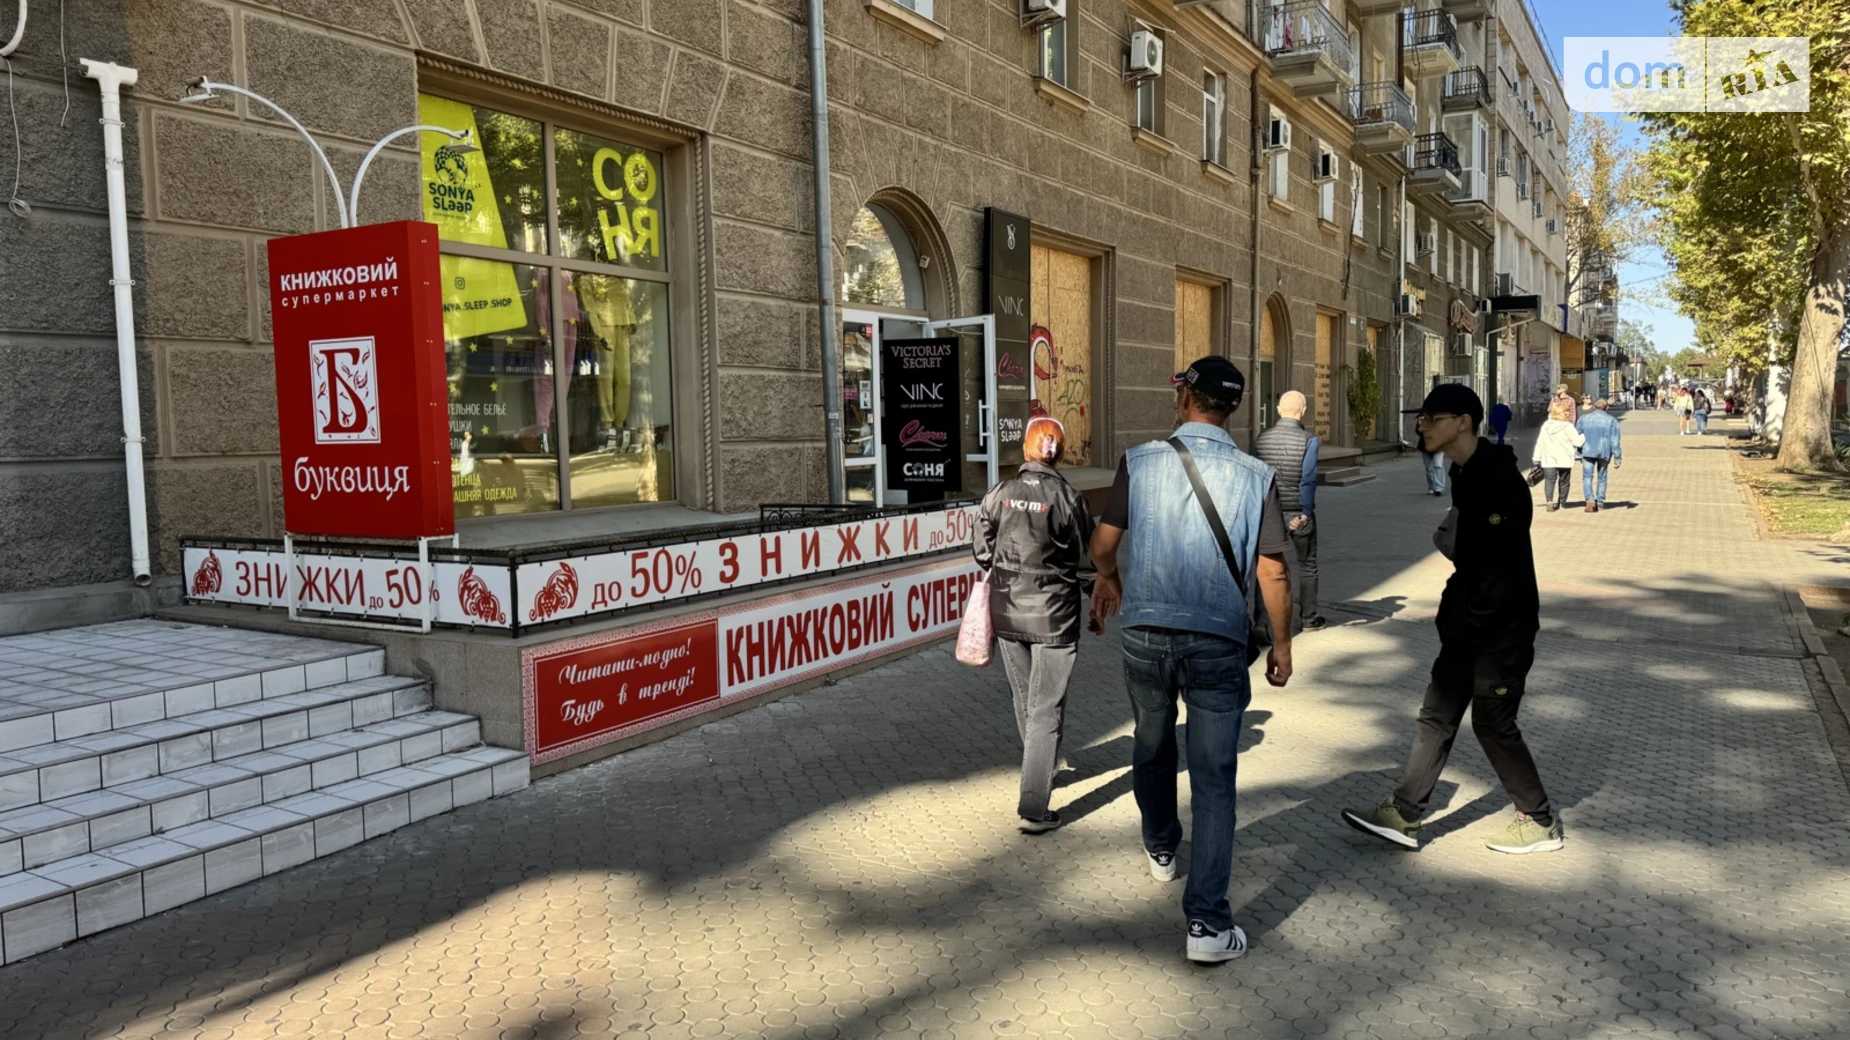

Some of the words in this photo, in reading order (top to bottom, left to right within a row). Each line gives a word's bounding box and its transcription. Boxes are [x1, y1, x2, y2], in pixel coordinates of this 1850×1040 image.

[428, 182, 475, 202] SONYA
[280, 257, 398, 291] КНИЖКОВИЙ
[282, 286, 399, 309] супермаркет
[891, 344, 952, 358] VICTORIA'S
[903, 357, 942, 369] SECRET
[900, 382, 944, 400] VINC
[998, 418, 1022, 431] SONYA
[294, 456, 411, 501] буквиця
[484, 487, 517, 501] ОДЕЖДА
[592, 580, 622, 610] до
[630, 549, 702, 598] 50%
[718, 516, 919, 584] ЗНИЖКИ
[929, 530, 944, 549] до
[235, 560, 365, 606] ЗНИЖКИ
[369, 595, 384, 610] до
[725, 582, 895, 687] КНИЖКОВИЙ
[558, 637, 692, 685] Читати-модно!
[560, 699, 605, 726] Будь
[617, 683, 628, 705] в
[638, 666, 696, 700] тренді!
